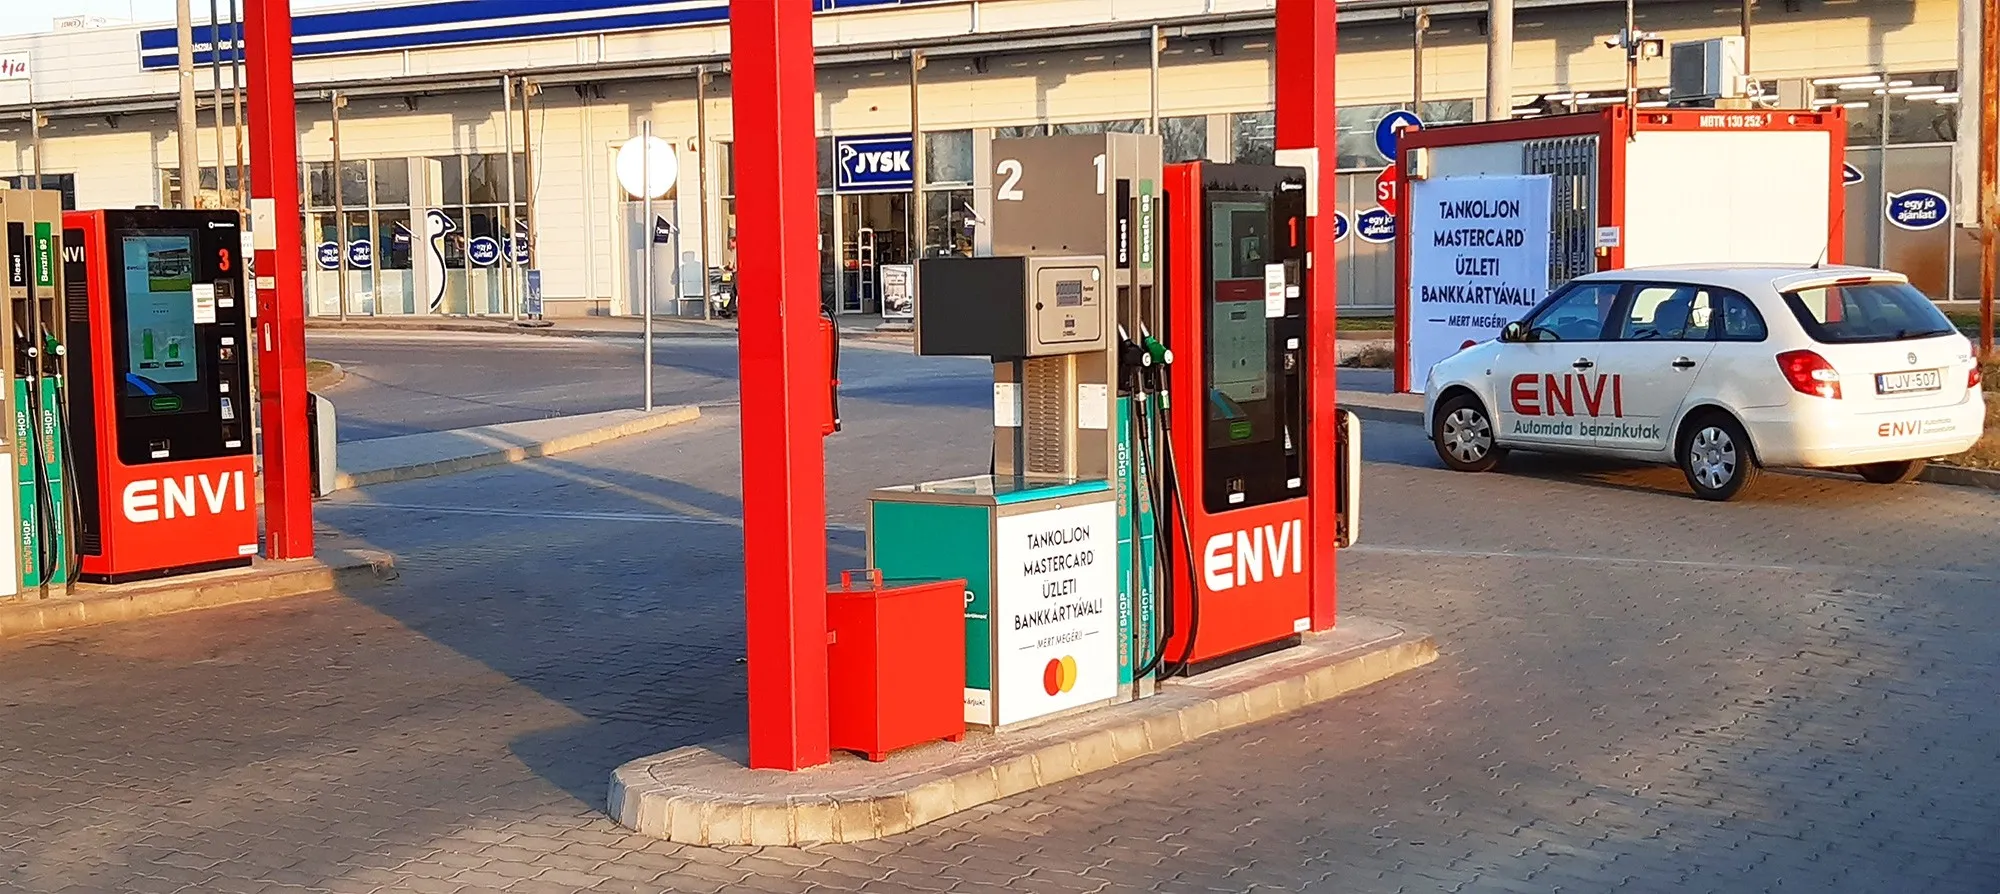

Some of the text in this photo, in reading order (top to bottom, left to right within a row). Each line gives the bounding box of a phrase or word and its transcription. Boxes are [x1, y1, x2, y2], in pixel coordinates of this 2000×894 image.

[1700, 115, 1725, 128] MBTK
[1727, 115, 1743, 128] 130
[855, 151, 911, 174] JYSK
[997, 159, 1024, 201] 2
[1093, 154, 1106, 195] 1
[1378, 181, 1396, 200] ST
[1439, 200, 1520, 219] TANKOLJON
[1904, 198, 1936, 210] egy jó
[1898, 210, 1937, 222] ajánlat!
[1119, 219, 1127, 263] Diesel
[1289, 216, 1297, 247] 1
[1433, 229, 1524, 247] MASTERCARD
[39, 238, 49, 282] Benzin 95
[62, 246, 85, 263] NVI
[219, 248, 230, 271] 3
[1456, 253, 1500, 276] ÜZLETI
[13, 254, 22, 282] Diesel
[1421, 280, 1536, 307] BANKKÁRTYÁVAL!
[1448, 315, 1471, 327] MERT
[1885, 372, 1937, 390] LJV-507
[1511, 374, 1623, 418] ENVI
[1513, 420, 1660, 440] Automata benzinkutak
[1878, 420, 1922, 437] ENVI
[122, 470, 246, 523] ENVI
[1027, 525, 1090, 550] TANKOLJON
[1023, 550, 1094, 577] MASTERCARD
[1203, 519, 1302, 592] ENVI
[1042, 578, 1077, 599] ÜZLETI
[1014, 597, 1102, 631] BANKKÁRTYÁVAL!
